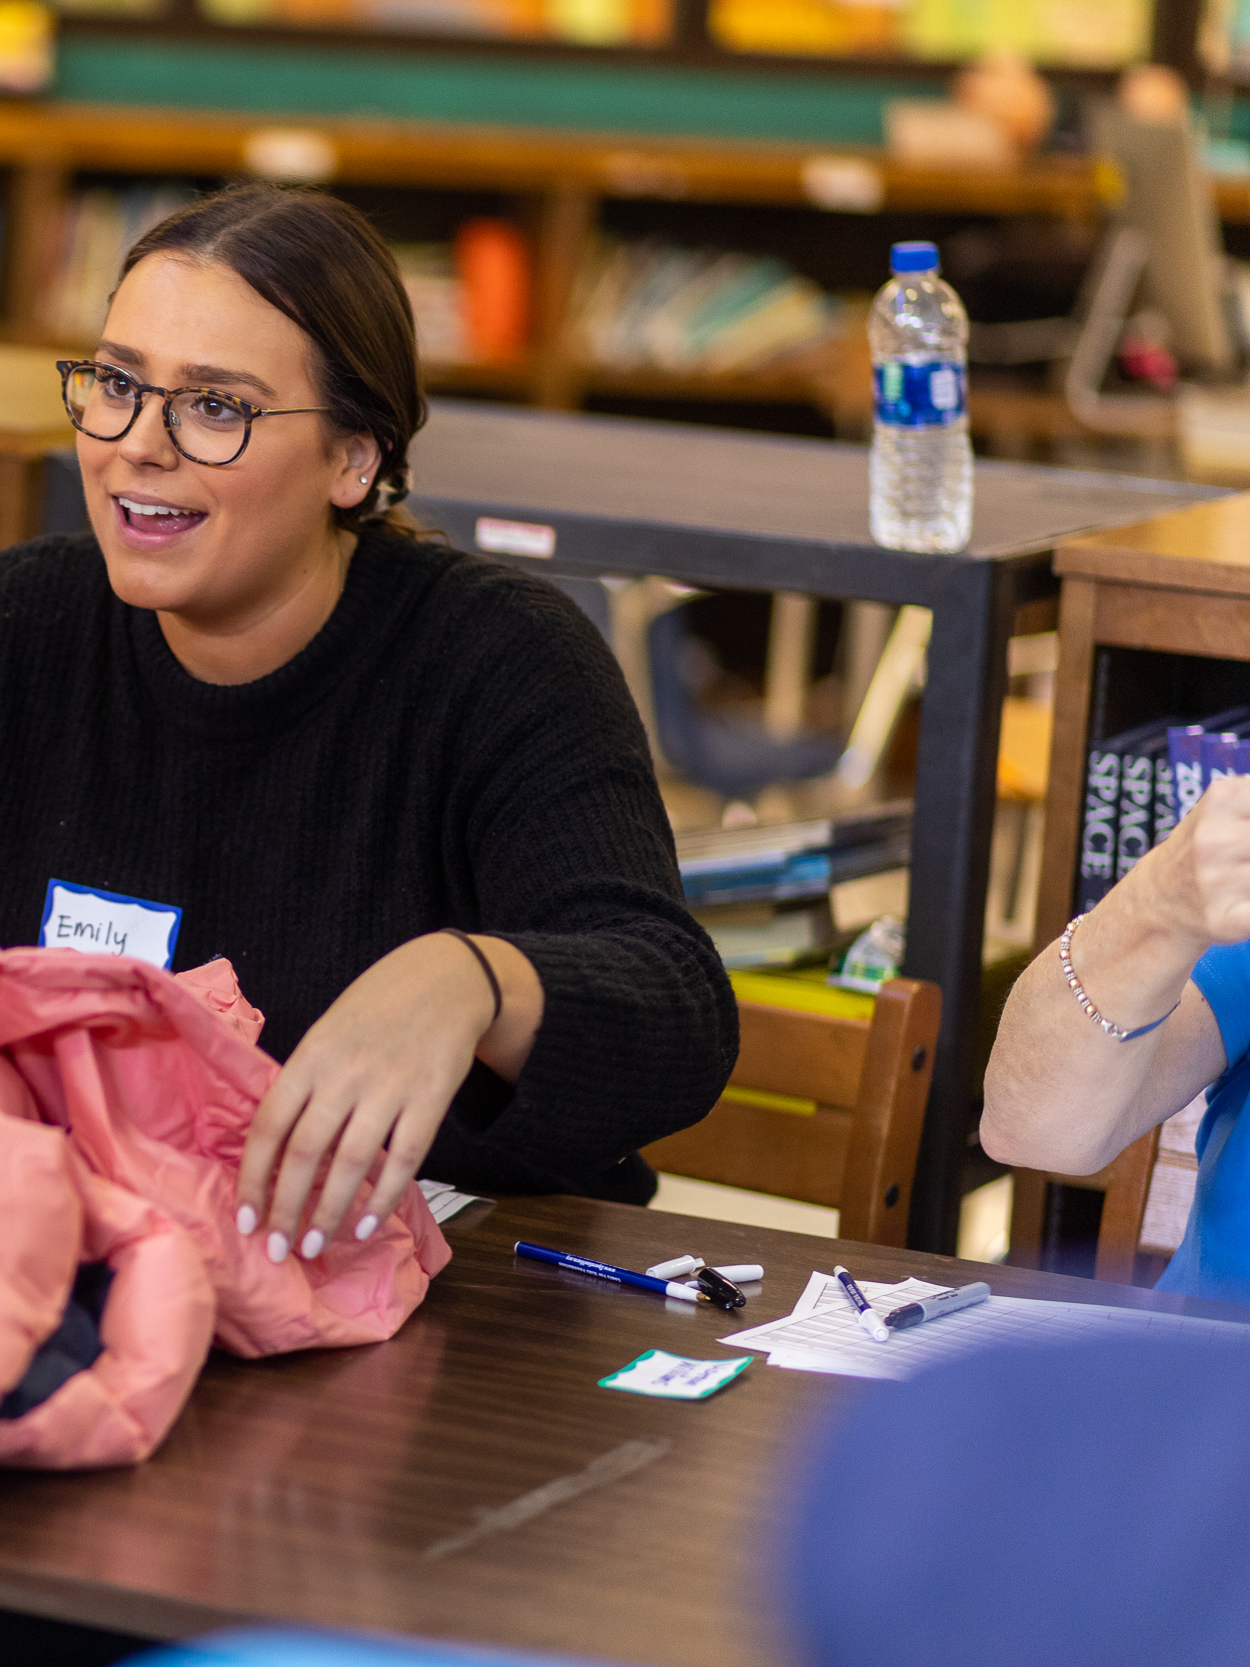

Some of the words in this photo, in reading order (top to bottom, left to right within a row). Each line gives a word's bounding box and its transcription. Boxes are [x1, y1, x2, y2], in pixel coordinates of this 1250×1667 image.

[1081, 750, 1120, 879] SPACE
[1154, 758, 1176, 848] SPA
[57, 914, 128, 957] Emily
